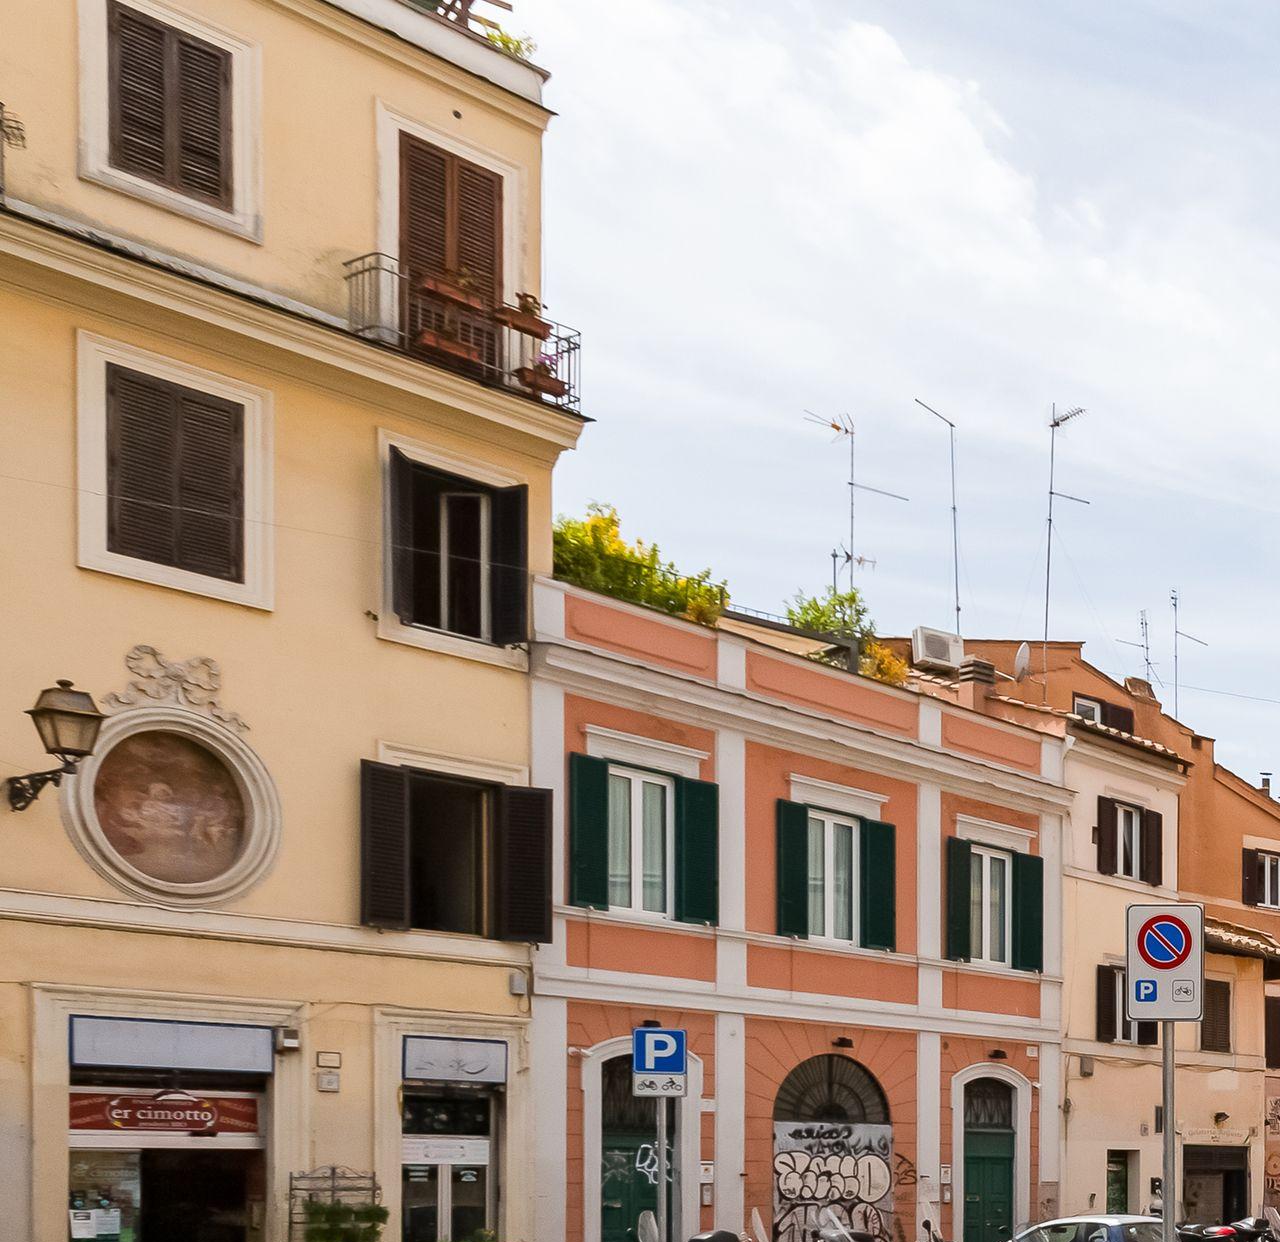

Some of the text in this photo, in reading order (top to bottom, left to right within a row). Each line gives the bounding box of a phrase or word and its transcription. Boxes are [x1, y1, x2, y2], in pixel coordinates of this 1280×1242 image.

[1140, 983, 1154, 999] P
[645, 1033, 677, 1069] P
[111, 1109, 132, 1119] er
[136, 1106, 212, 1121] cimotto
